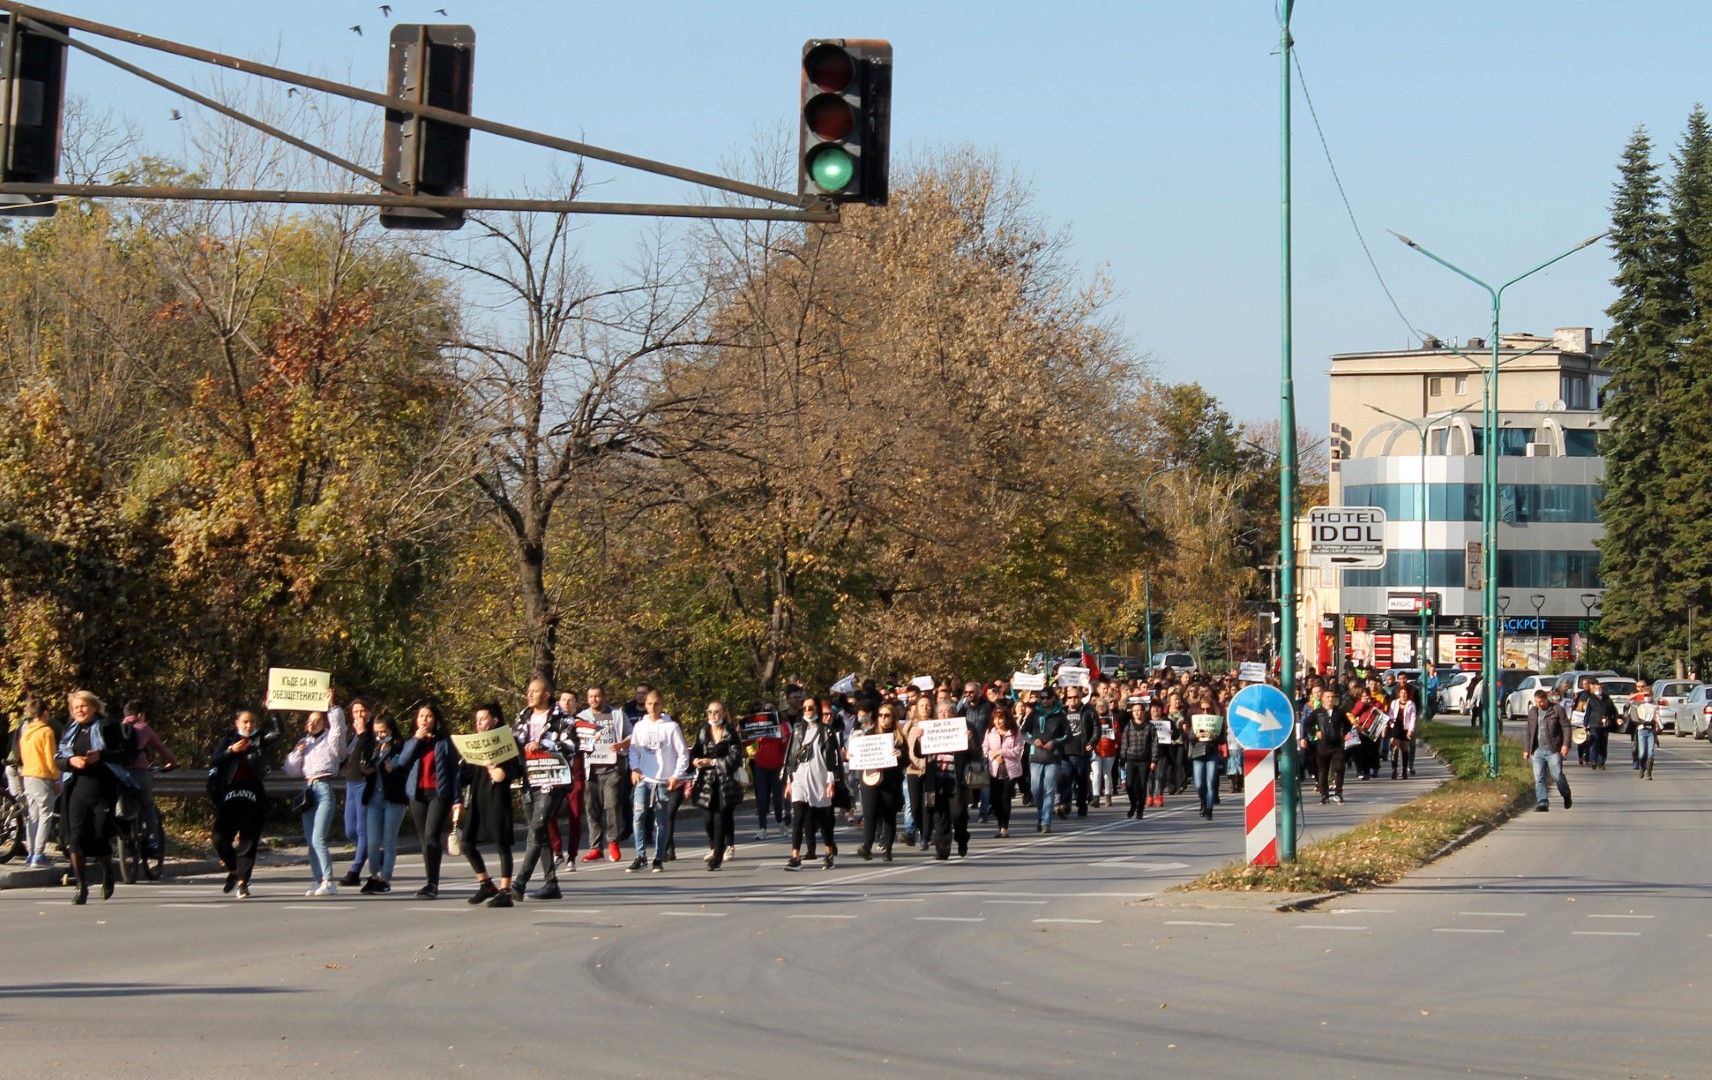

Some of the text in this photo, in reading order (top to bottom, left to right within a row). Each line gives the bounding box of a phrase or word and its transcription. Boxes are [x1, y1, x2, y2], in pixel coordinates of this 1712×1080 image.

[1311, 512, 1382, 523] HOTEL
[1311, 526, 1382, 542] IDOL
[282, 676, 319, 688] КЪДЕ СА НИ
[224, 789, 257, 802] ATLANTA
